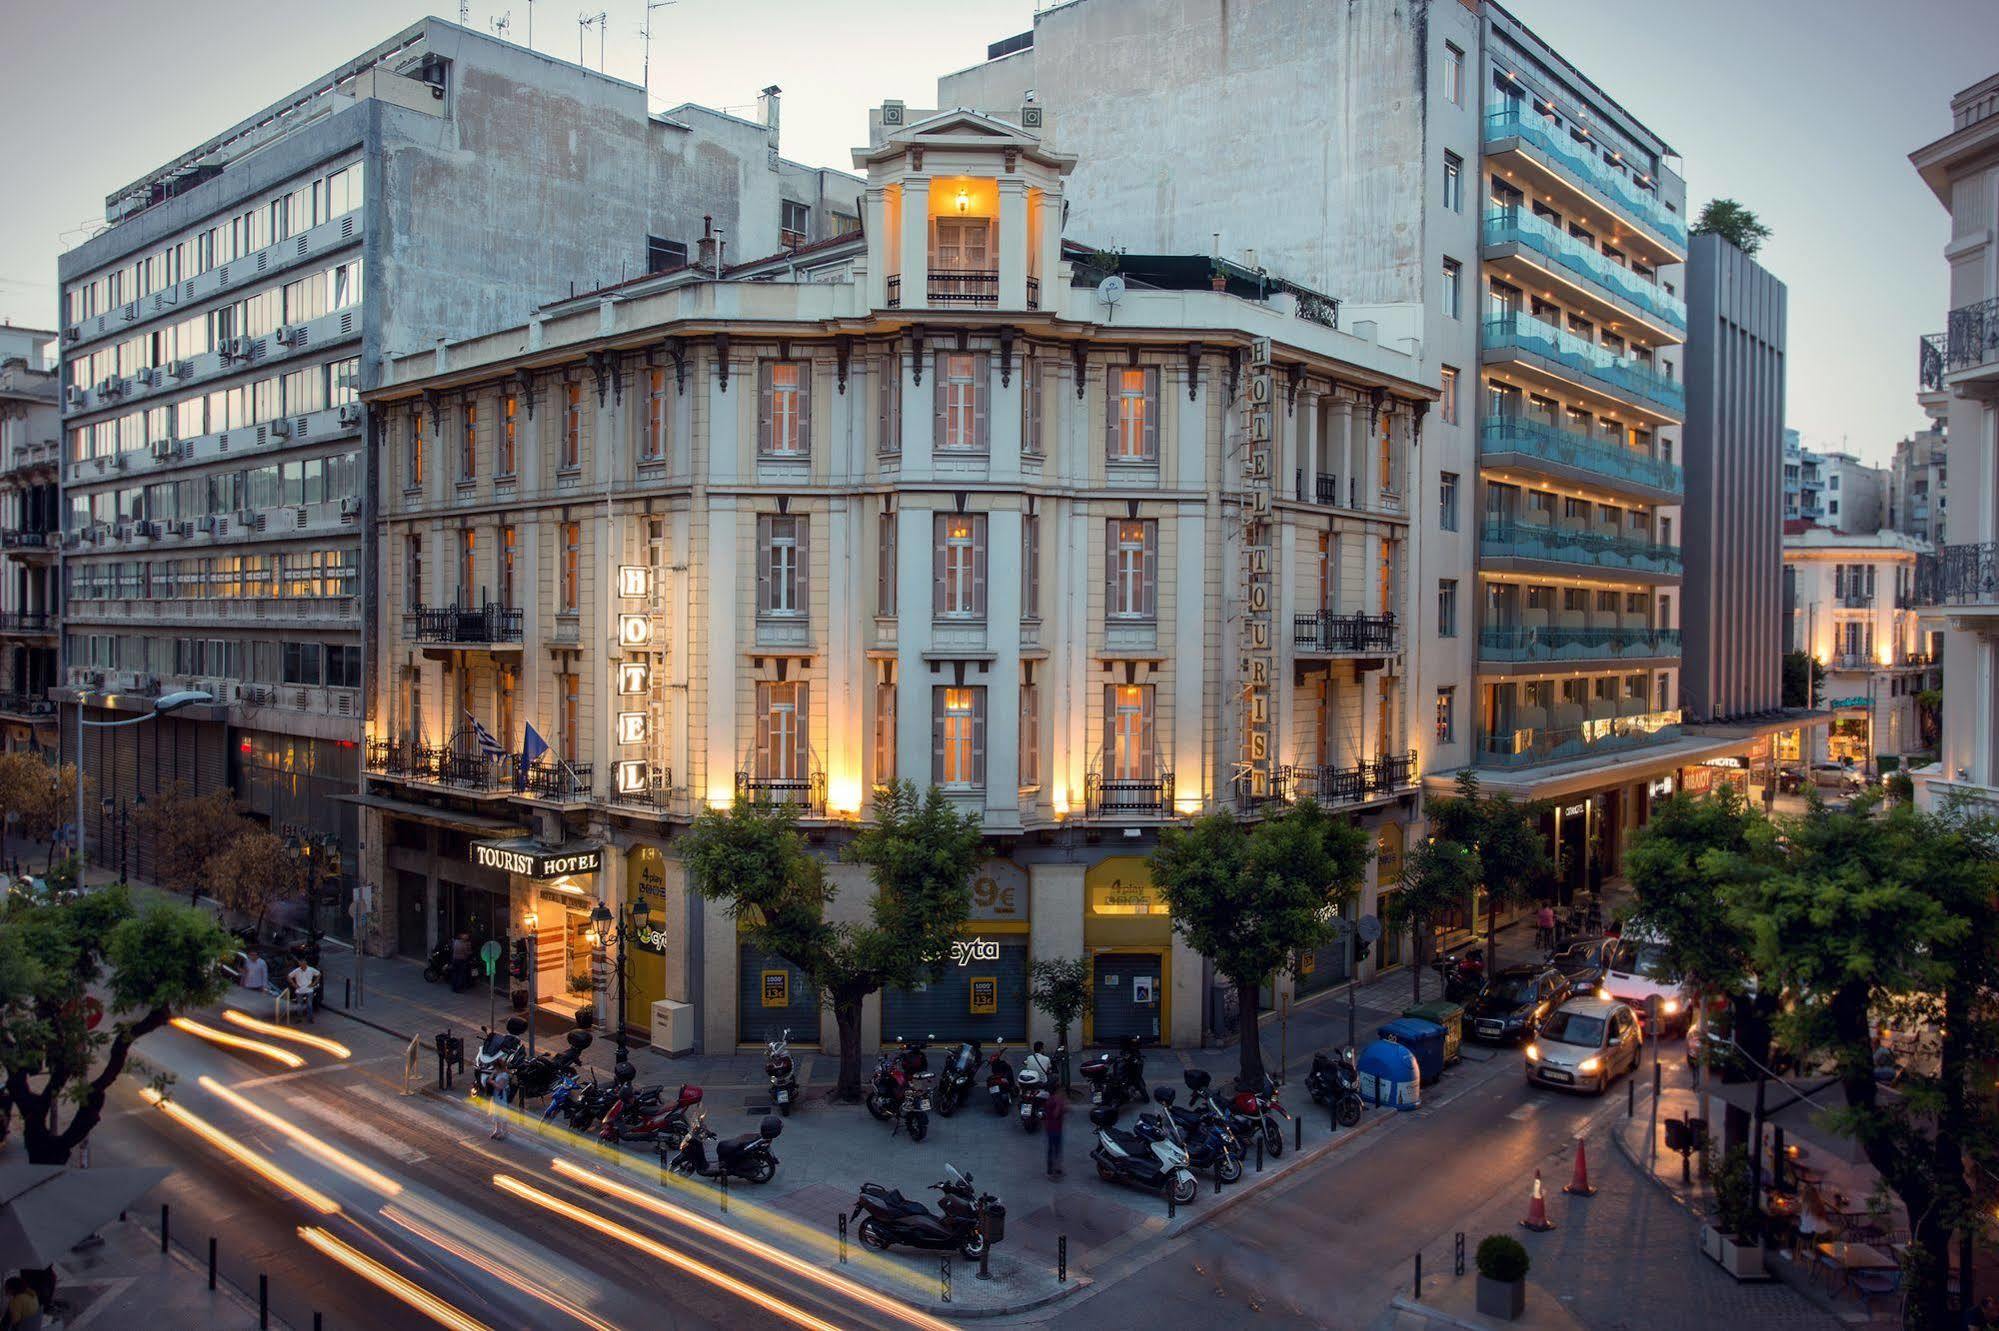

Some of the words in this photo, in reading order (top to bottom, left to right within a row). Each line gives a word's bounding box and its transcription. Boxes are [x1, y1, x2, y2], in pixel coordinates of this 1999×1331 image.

[1251, 341, 1270, 516] HOTEL
[622, 566, 648, 791] HOTEL
[1251, 547, 1270, 797] TOURIST
[477, 845, 534, 876] TOURIST
[543, 853, 599, 875] HOTEL
[949, 936, 1000, 967] cyta
